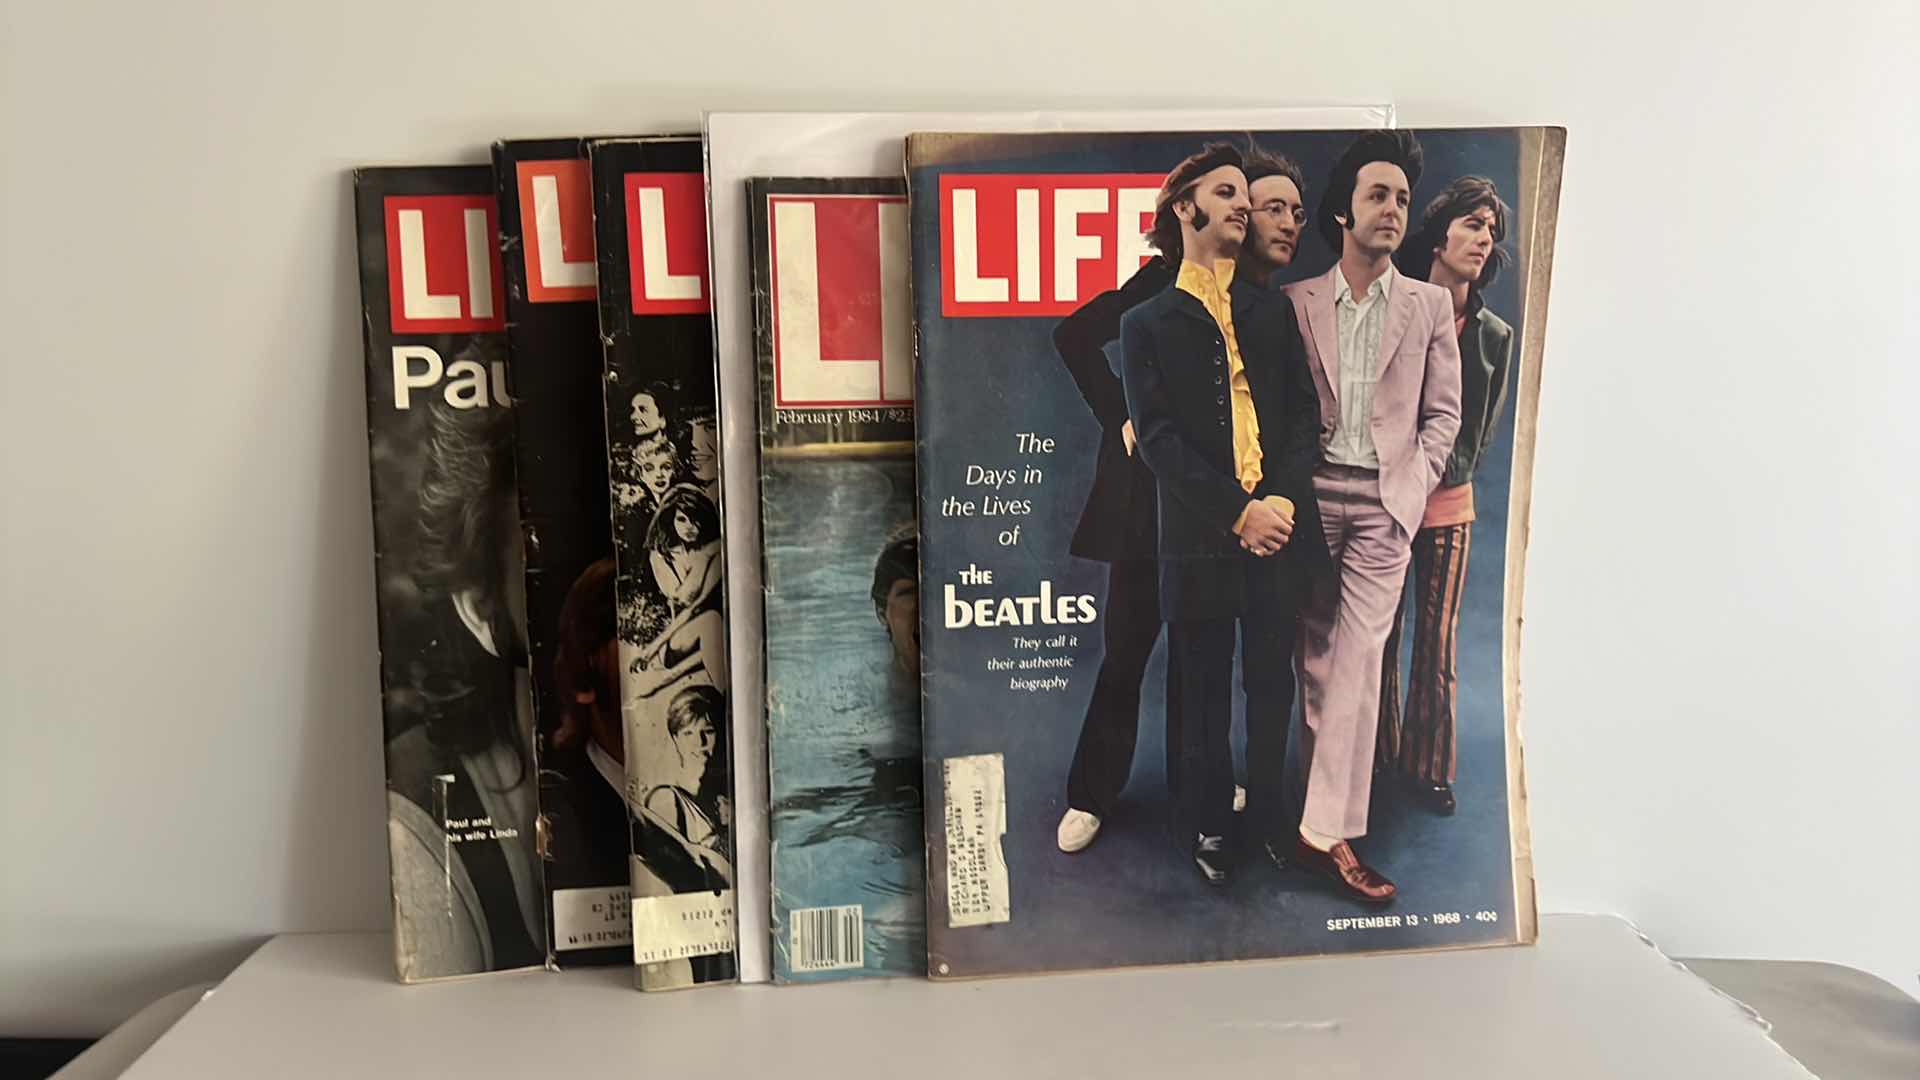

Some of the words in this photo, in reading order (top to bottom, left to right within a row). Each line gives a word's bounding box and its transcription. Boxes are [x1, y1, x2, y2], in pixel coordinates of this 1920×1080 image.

[776, 409, 842, 427] February
[1016, 432, 1055, 454] The
[966, 465, 1016, 490] Days
[1024, 464, 1042, 484] in
[942, 496, 975, 516] the
[983, 495, 1032, 516] Lives
[998, 525, 1020, 545] of
[1012, 636, 1042, 651] They
[1046, 635, 1066, 648] call
[1069, 634, 1079, 647] it
[987, 657, 1015, 671] their
[1018, 655, 1075, 669] authentic
[1010, 674, 1069, 692] biography
[445, 818, 468, 829] Paul
[472, 816, 492, 827] and
[446, 833, 462, 843] his
[465, 831, 487, 841] wife
[489, 828, 518, 839] Linda
[1327, 915, 1401, 931] SEPTEMBER
[1407, 915, 1419, 926] 13
[1433, 912, 1461, 925] 1968
